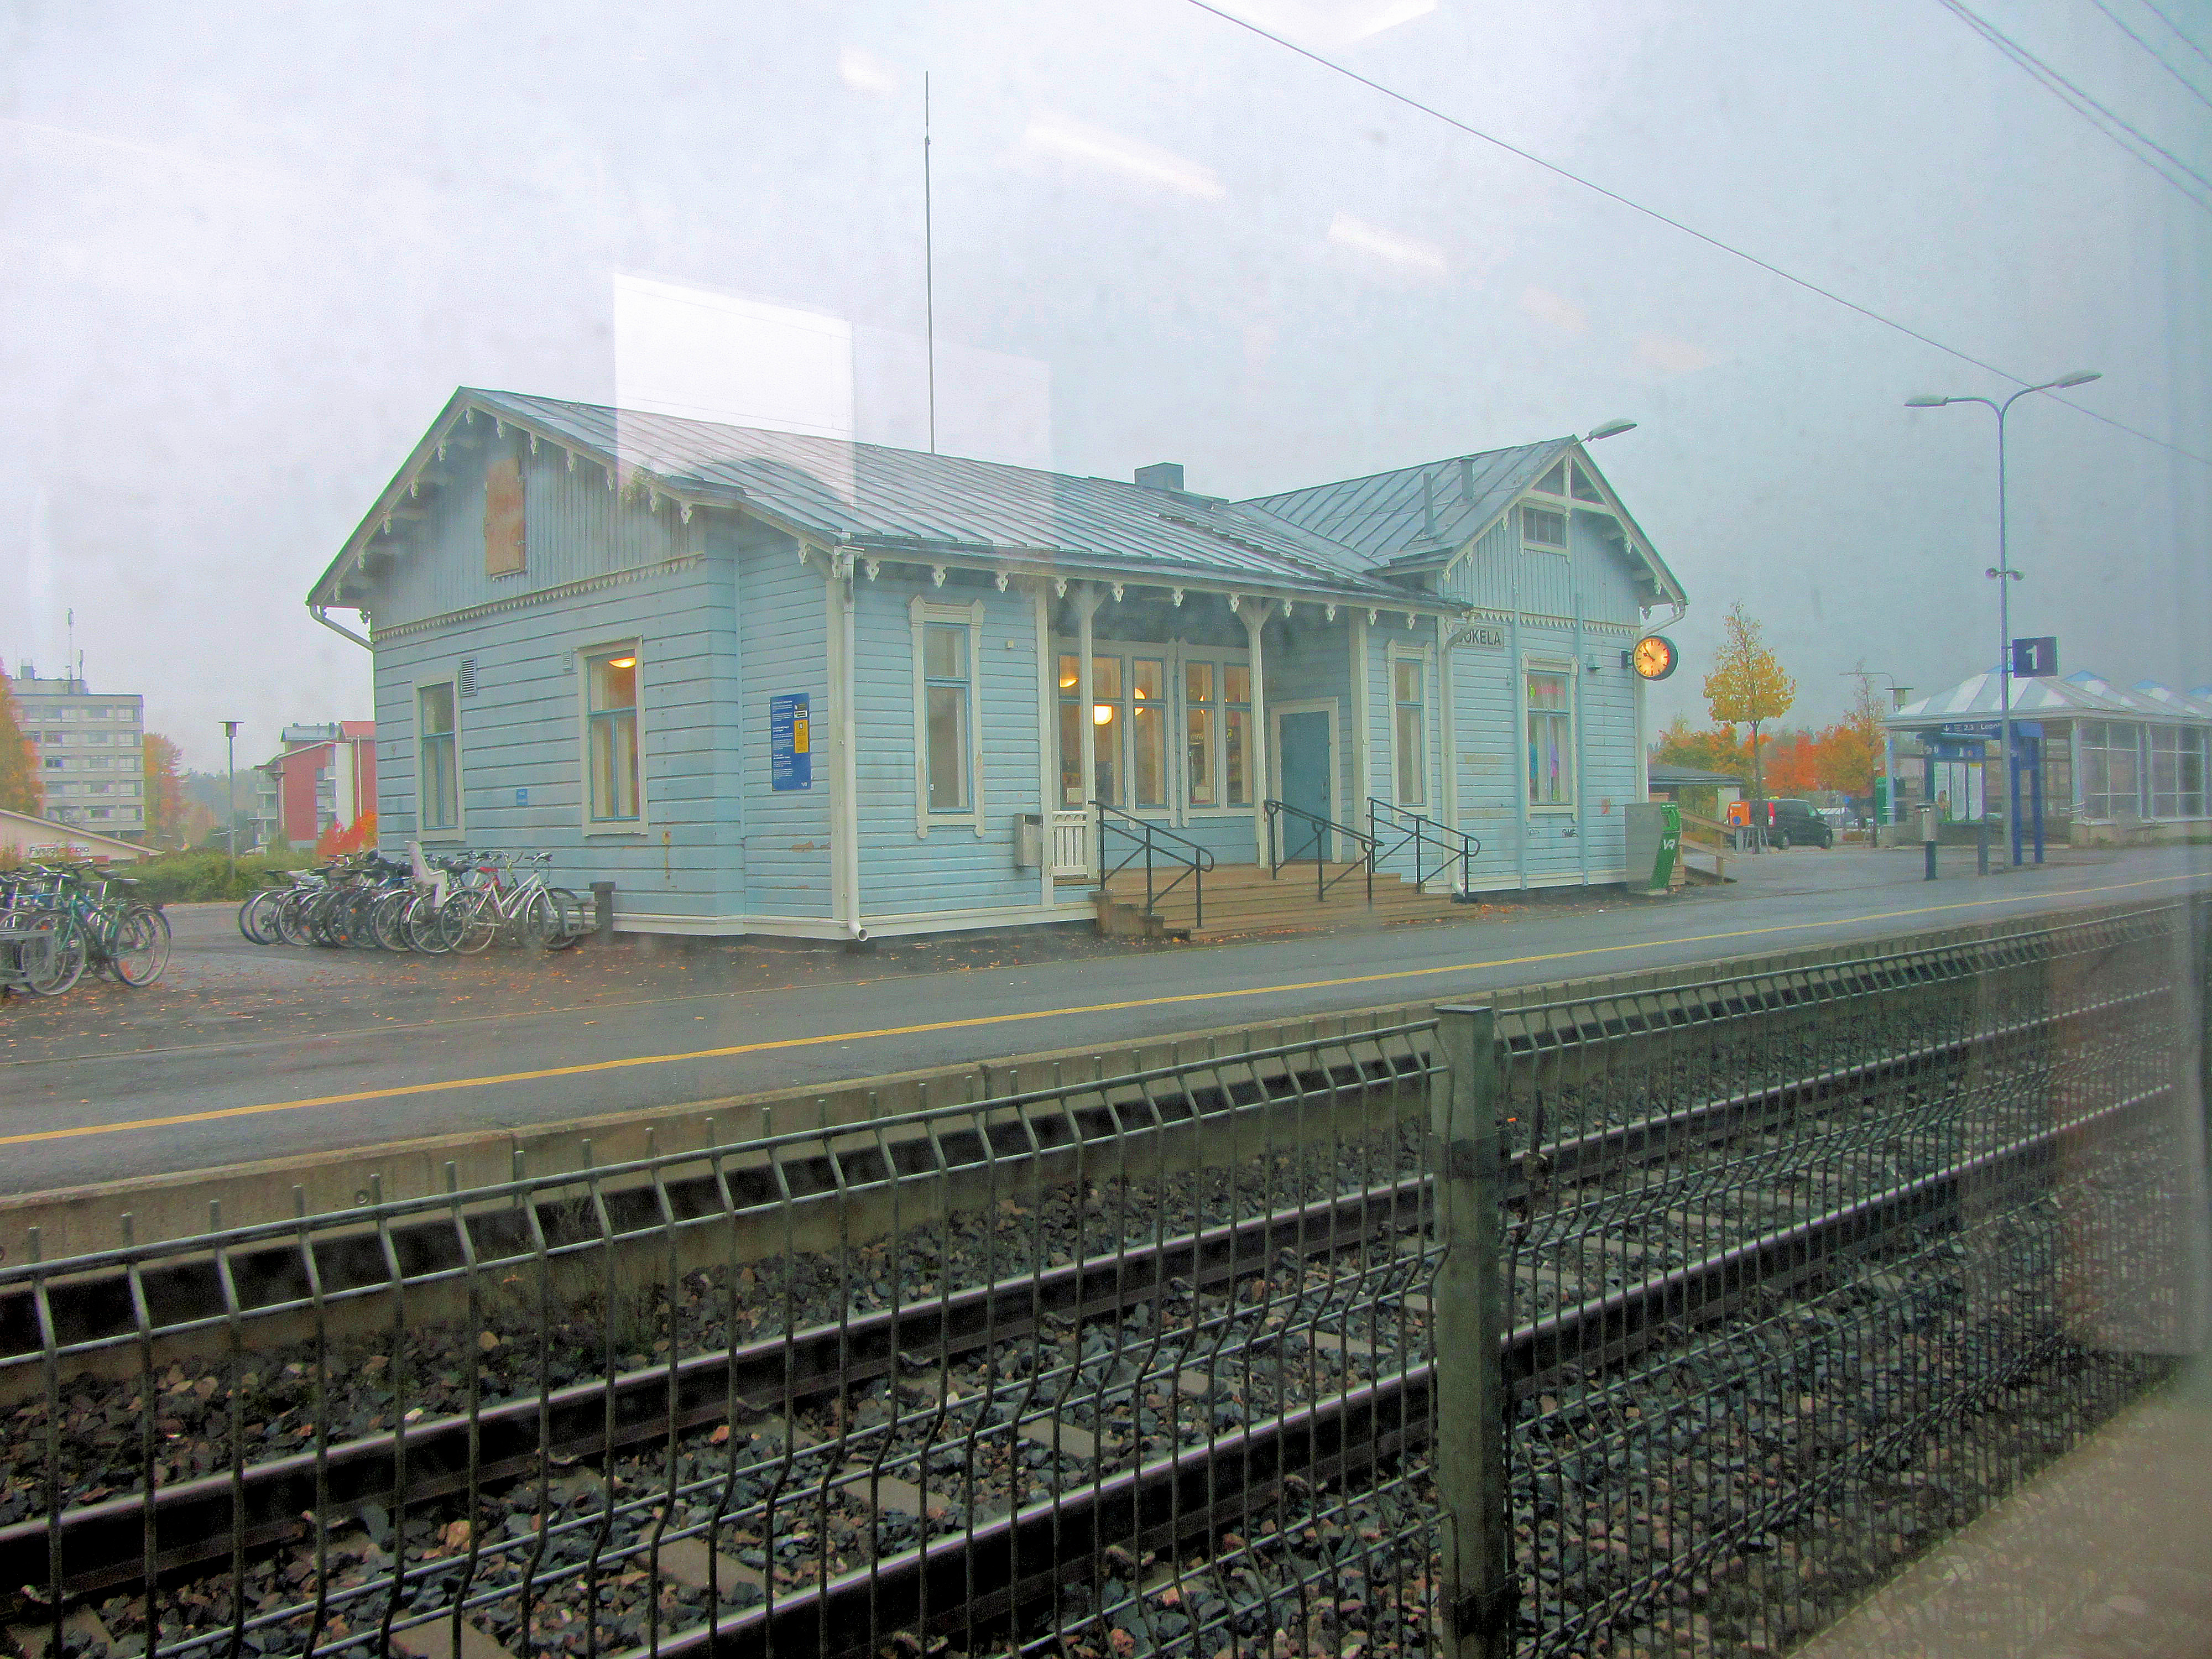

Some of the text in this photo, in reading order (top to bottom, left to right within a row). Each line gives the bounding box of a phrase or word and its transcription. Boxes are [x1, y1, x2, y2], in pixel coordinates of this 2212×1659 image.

[1460, 629, 1501, 646] OKELA
[2026, 645, 2038, 670] 1
[1663, 839, 1676, 850] VR
